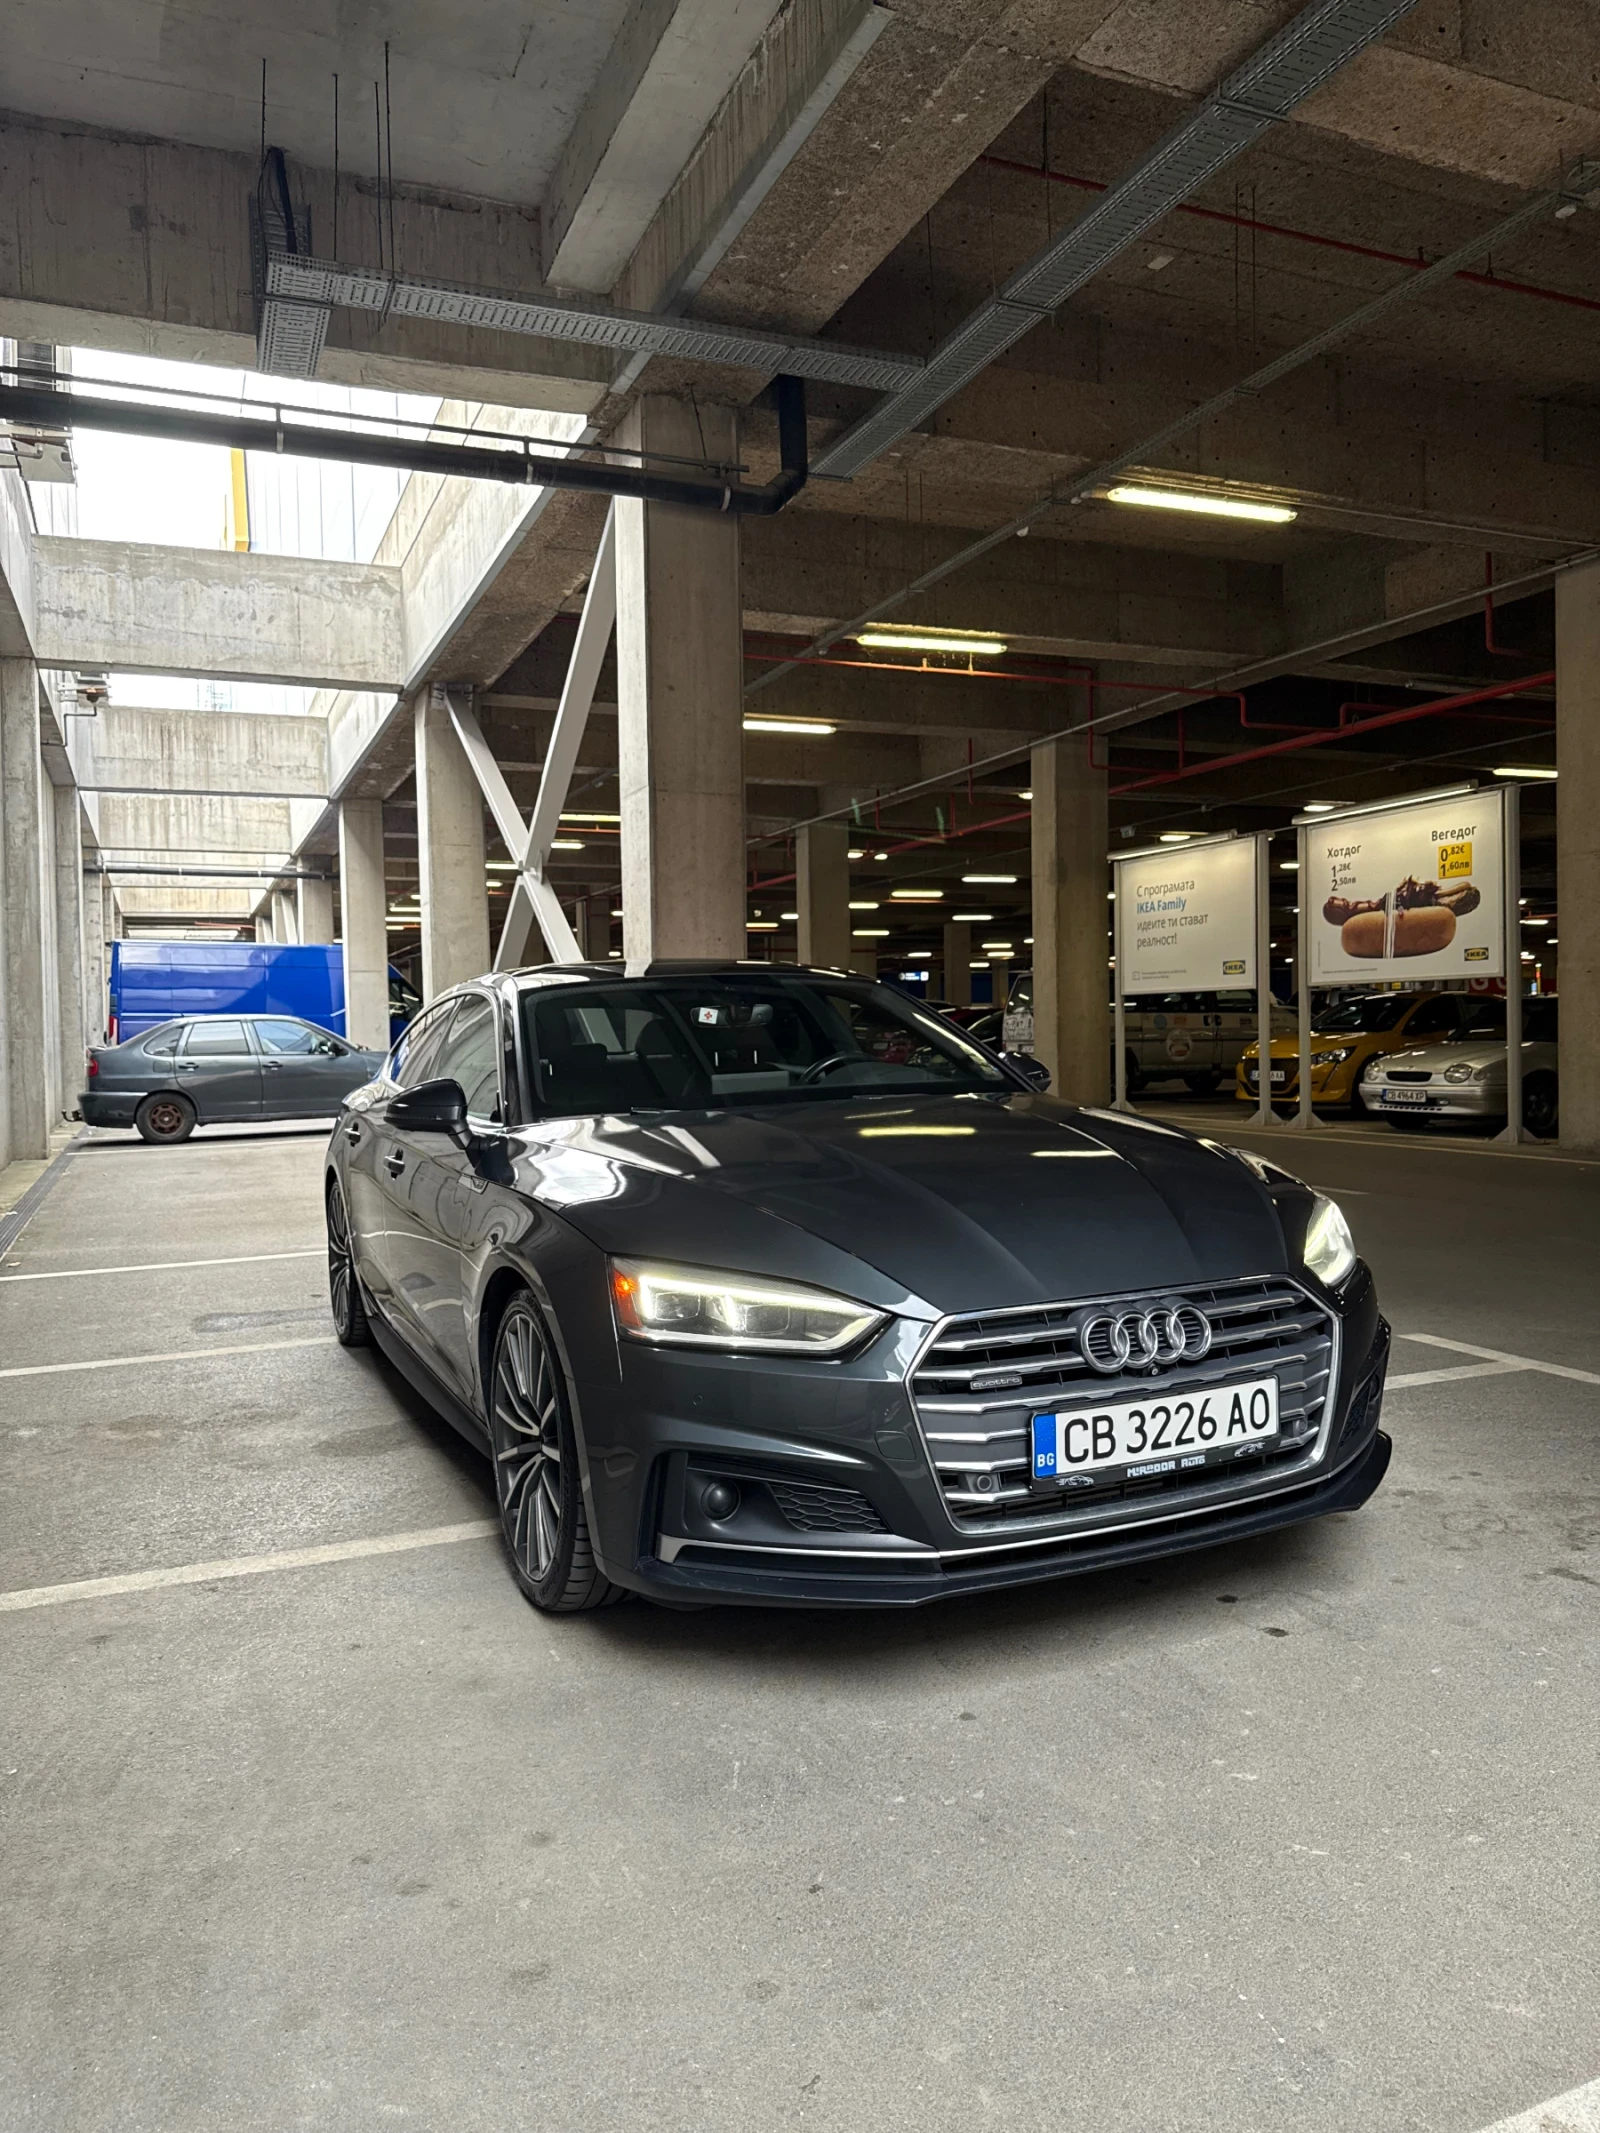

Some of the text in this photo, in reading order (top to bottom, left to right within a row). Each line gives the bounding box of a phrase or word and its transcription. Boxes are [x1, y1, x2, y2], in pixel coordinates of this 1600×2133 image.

[1431, 825, 1477, 842] Вегедог
[1327, 844, 1362, 859] Хотдог
[1136, 880, 1195, 898] С програмата
[1136, 897, 1187, 914] IKEA Family
[1136, 914, 1208, 933] идеите ти стават
[1136, 933, 1177, 950] реалност!
[1465, 949, 1488, 959] IKEA
[1224, 963, 1245, 972] IKEA
[972, 1377, 1020, 1388] quattro
[1064, 1388, 1270, 1464] CB 3226 AO
[1036, 1453, 1055, 1468] BG
